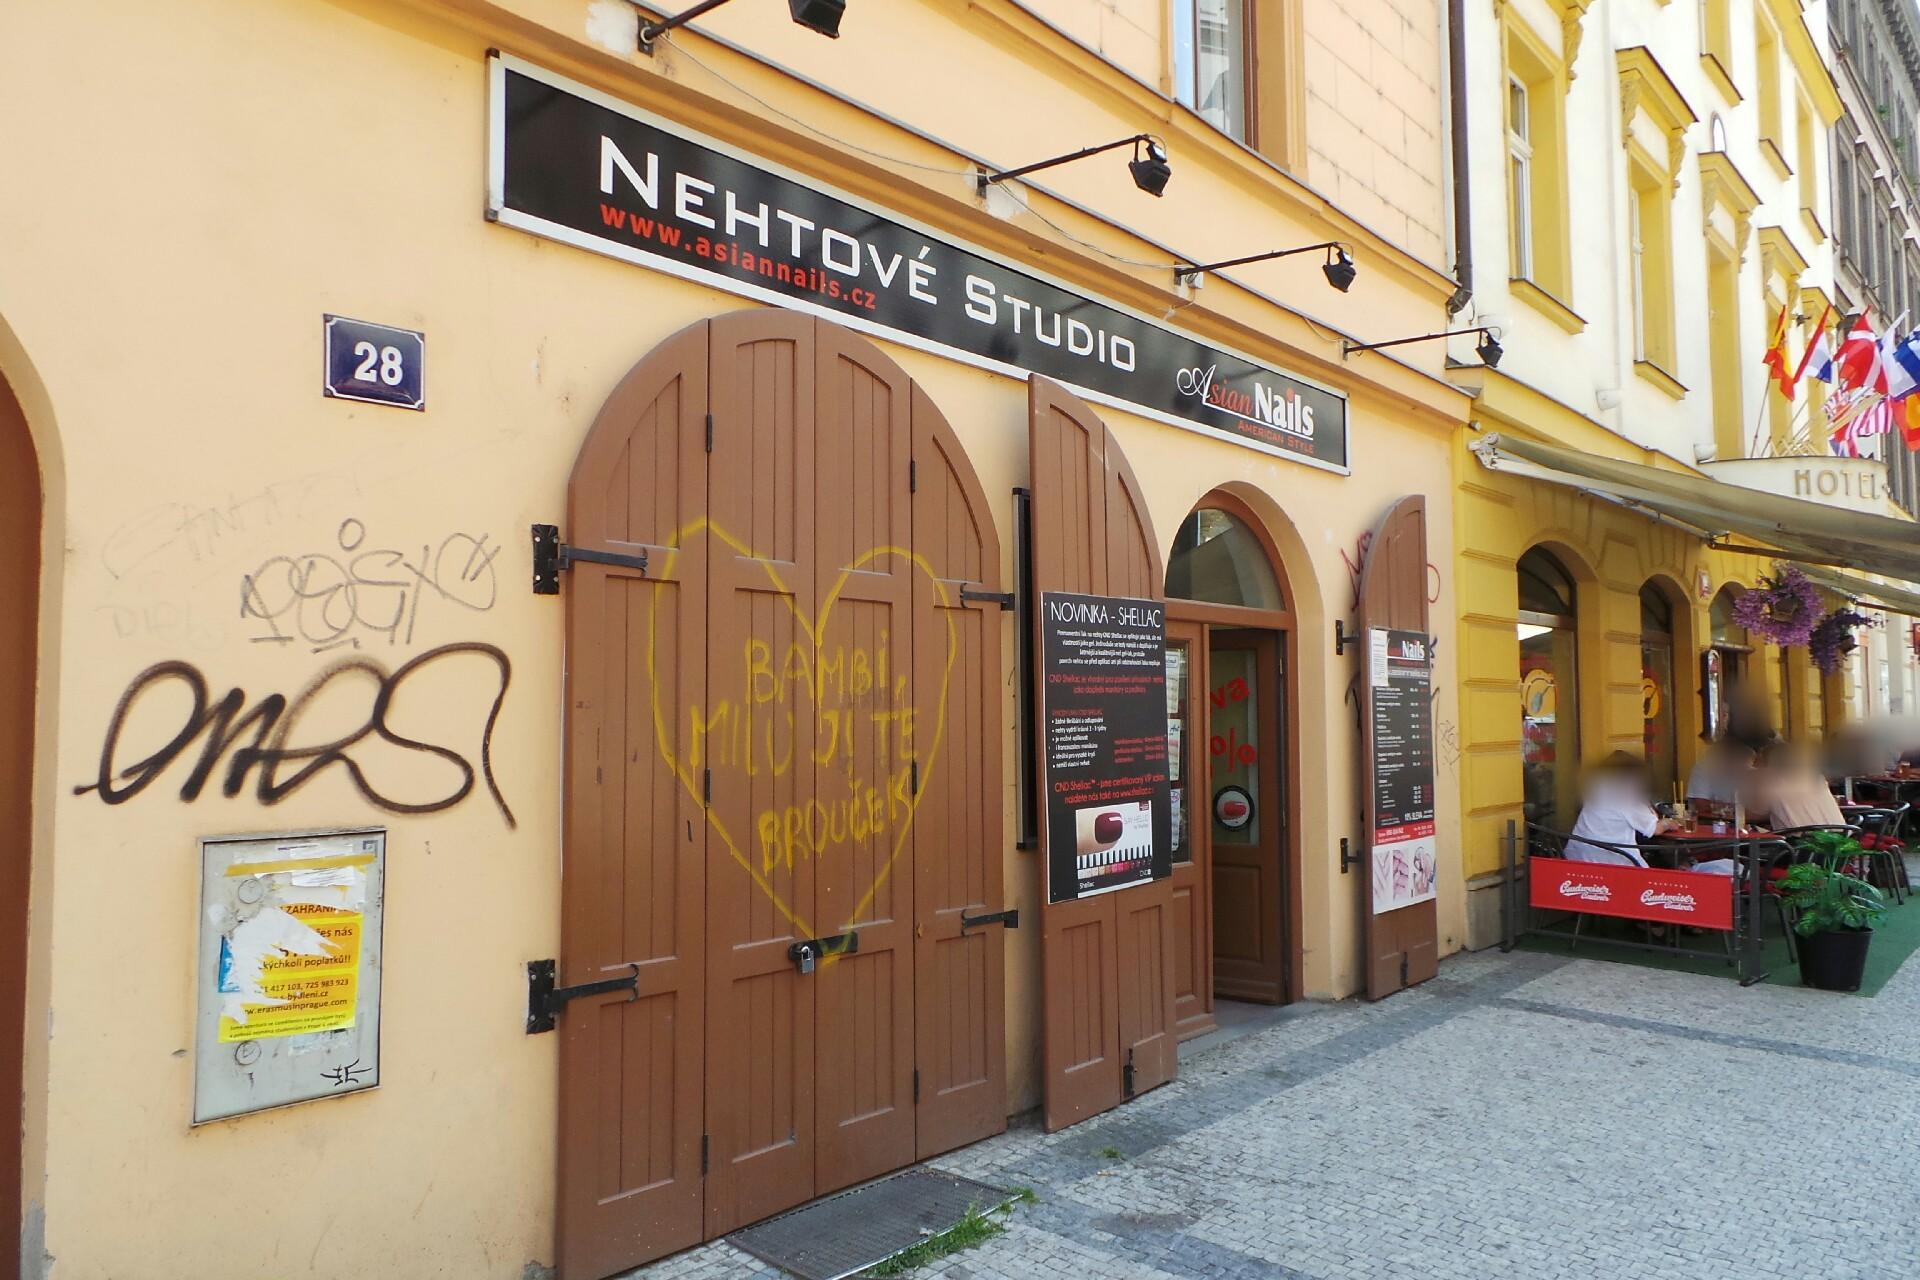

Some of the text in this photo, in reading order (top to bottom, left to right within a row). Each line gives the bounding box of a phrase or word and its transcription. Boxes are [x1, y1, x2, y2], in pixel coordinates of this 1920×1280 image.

[600, 134, 1136, 373] NEHTOVÉ STUDIO
[600, 203, 878, 311] www.asiannails.cz
[354, 341, 403, 386] 28
[1176, 364, 1314, 436] Asian Nails
[1794, 469, 1881, 500] HOTEL
[1050, 601, 1108, 624] NOVINKA
[1118, 606, 1161, 628] SHELLAC
[1402, 640, 1425, 659] Nails
[334, 927, 353, 937] nás
[261, 958, 302, 970] kýchkoli
[270, 984, 284, 992] 417
[305, 981, 319, 989] 725
